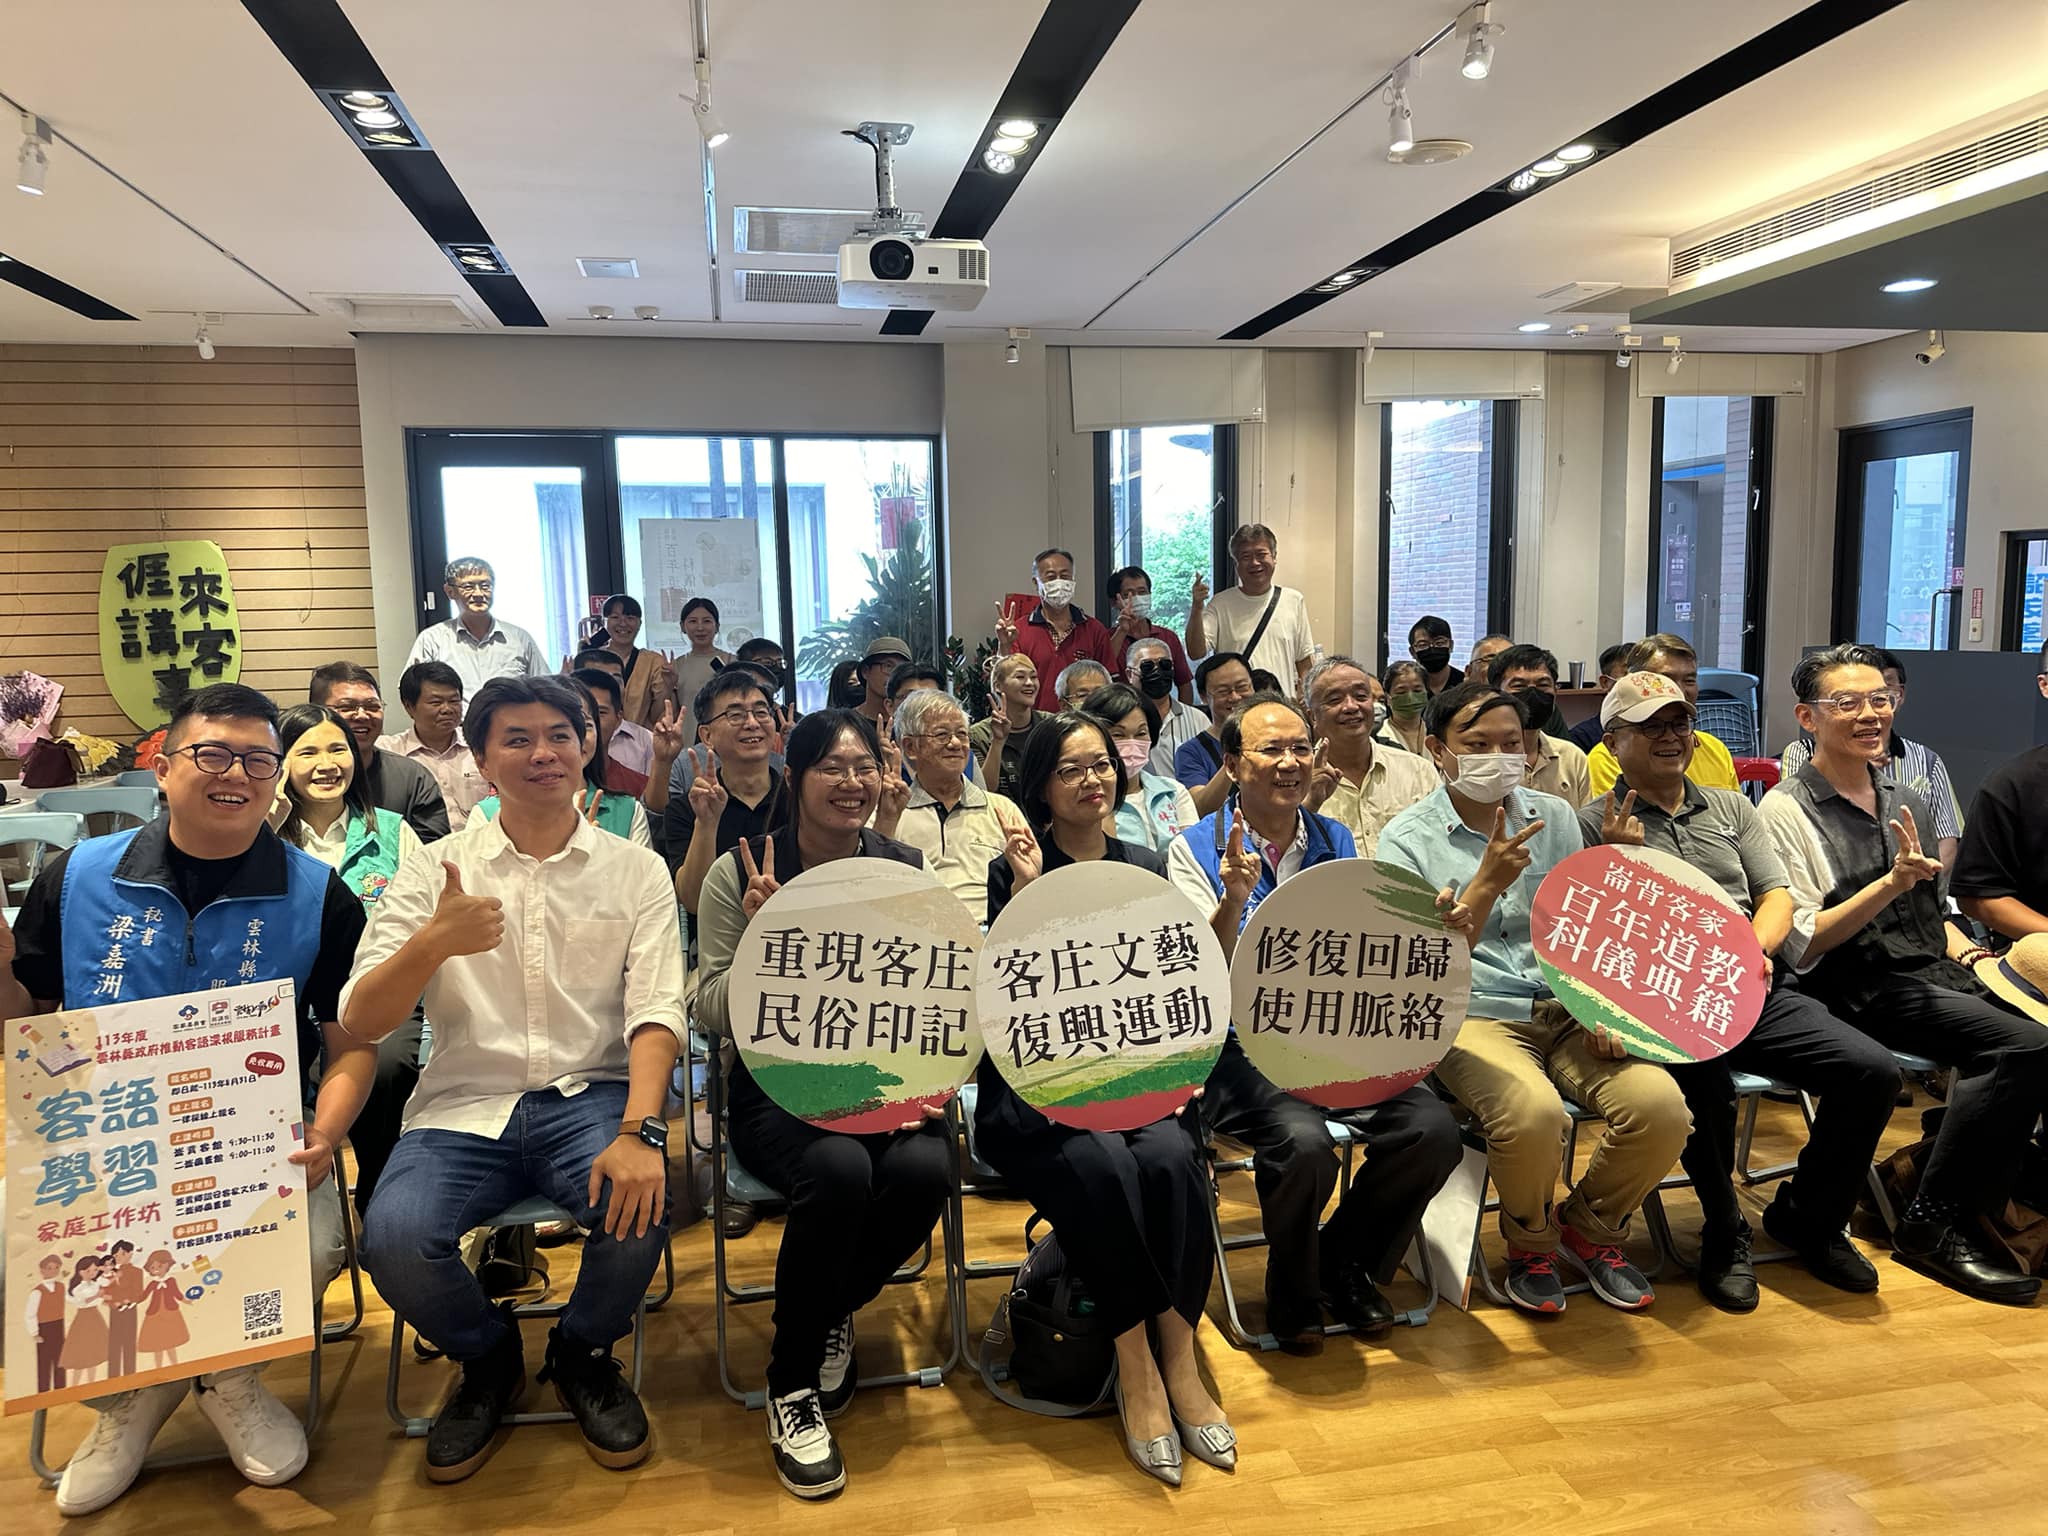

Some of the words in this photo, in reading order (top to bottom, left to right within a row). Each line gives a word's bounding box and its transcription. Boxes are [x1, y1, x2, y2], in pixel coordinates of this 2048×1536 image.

[140, 906, 164, 946] 秘書
[1602, 861, 1729, 938] 崙背客家
[93, 914, 135, 999] 梁嘉洲
[238, 918, 264, 985] 雲林縣
[755, 926, 974, 991] 重現客庄
[993, 921, 1200, 1002] 客庄文藝
[1255, 926, 1452, 981] 修復回歸
[1560, 876, 1747, 995] 百年道教
[1544, 915, 1736, 1036] 科儀典籍
[95, 1030, 148, 1049] 113年度
[750, 991, 968, 1057] 民俗印記
[1005, 985, 1213, 1069] 復興運動
[1249, 986, 1445, 1041] 使用脈絡
[36, 1076, 159, 1144] 客語
[36, 1139, 158, 1208] 學習
[37, 1201, 162, 1243] 家庭工作坊
